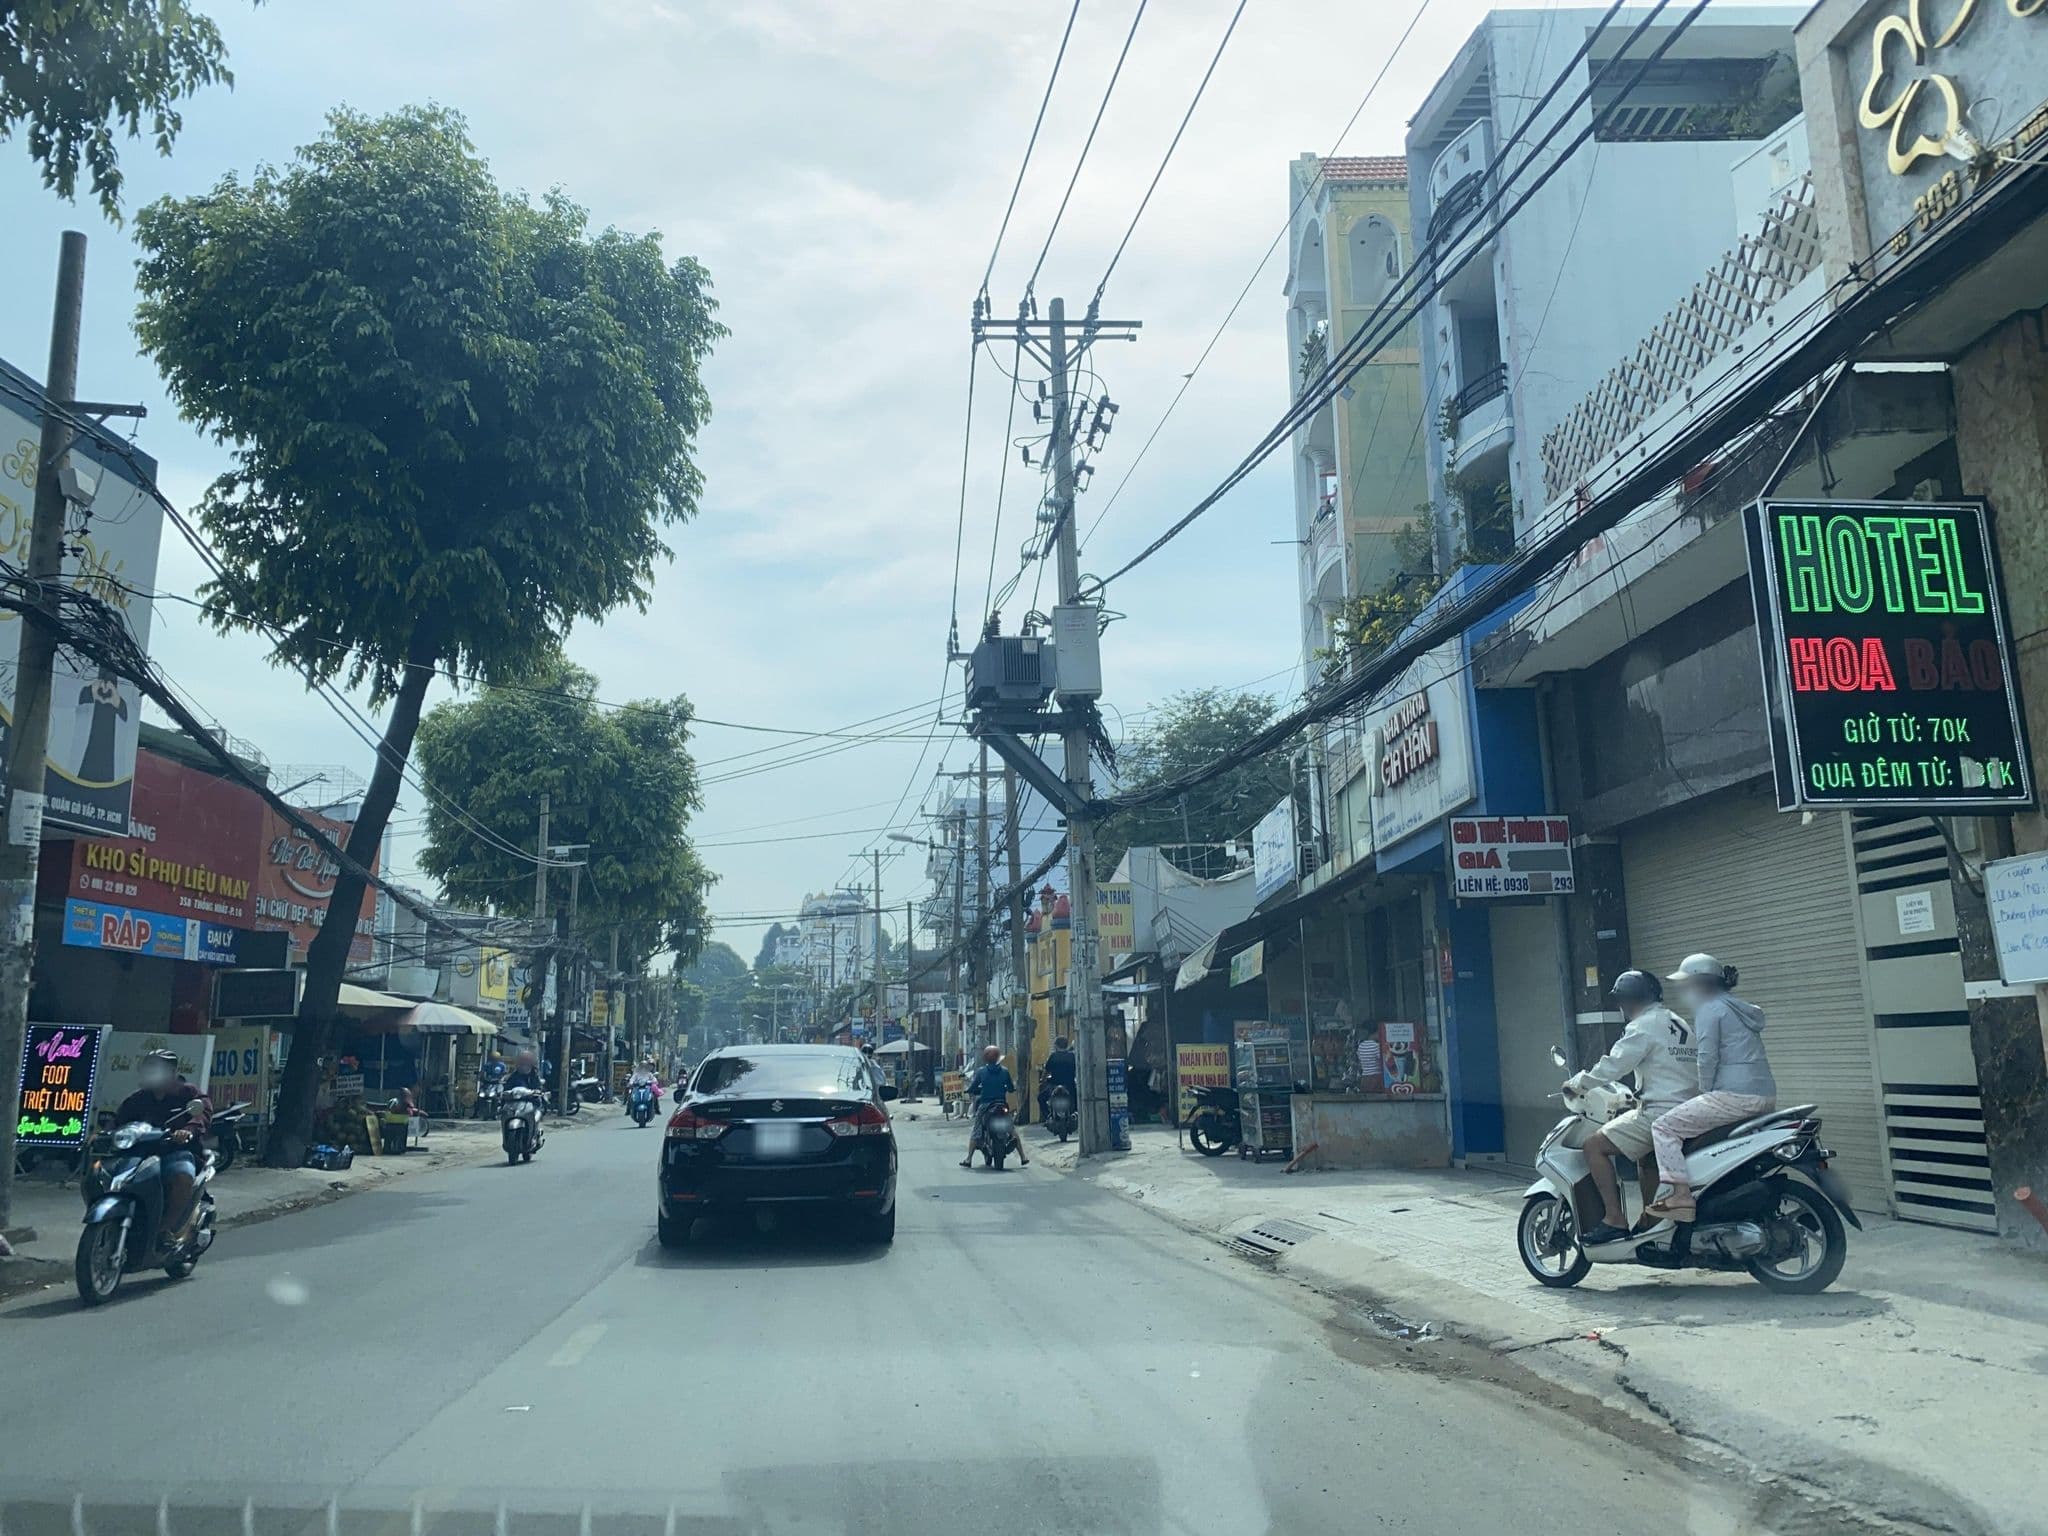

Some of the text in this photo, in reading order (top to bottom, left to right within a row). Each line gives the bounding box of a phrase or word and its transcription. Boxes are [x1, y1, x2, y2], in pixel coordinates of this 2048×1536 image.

[1778, 515, 1985, 613] HOTEL
[1790, 637, 1897, 691] HOA
[1844, 712, 1970, 743] GIỜ TỪ: 70K
[1381, 750, 1402, 787] GIA
[1811, 762, 1855, 791] QUA
[1861, 757, 1912, 787] ĐÊM
[1918, 756, 1953, 787] TỪ:
[86, 843, 250, 900] KHO SỈ PHỤ LIỆU MAY
[1458, 875, 1573, 894] LIÊN HỆ: 0938 293
[208, 929, 233, 948] ĐẠI LÝ
[41, 1065, 72, 1085] FOOT
[23, 1087, 85, 1112] TRIỆT LÔNG
